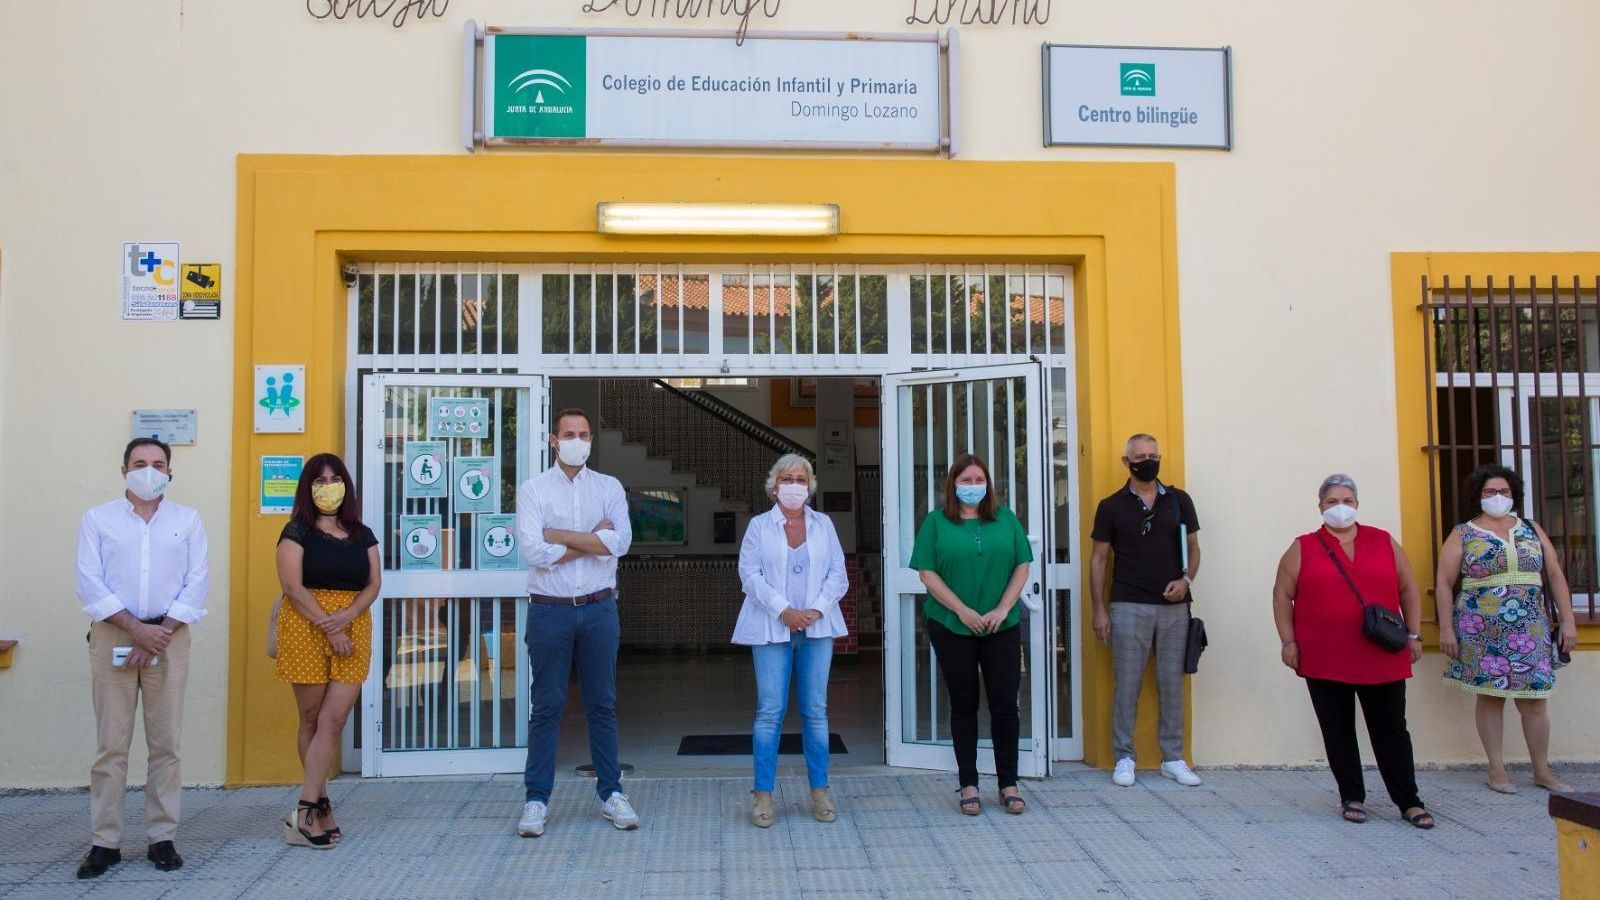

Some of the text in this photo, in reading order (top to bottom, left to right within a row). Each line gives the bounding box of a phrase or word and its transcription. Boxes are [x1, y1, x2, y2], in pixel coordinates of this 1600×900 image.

[602, 74, 918, 97] Colegio de Educación Infantil y Primaria
[506, 105, 527, 113] JUNTA
[791, 101, 918, 121] Domingo Lozano
[1078, 104, 1198, 128] Centro bilingüe
